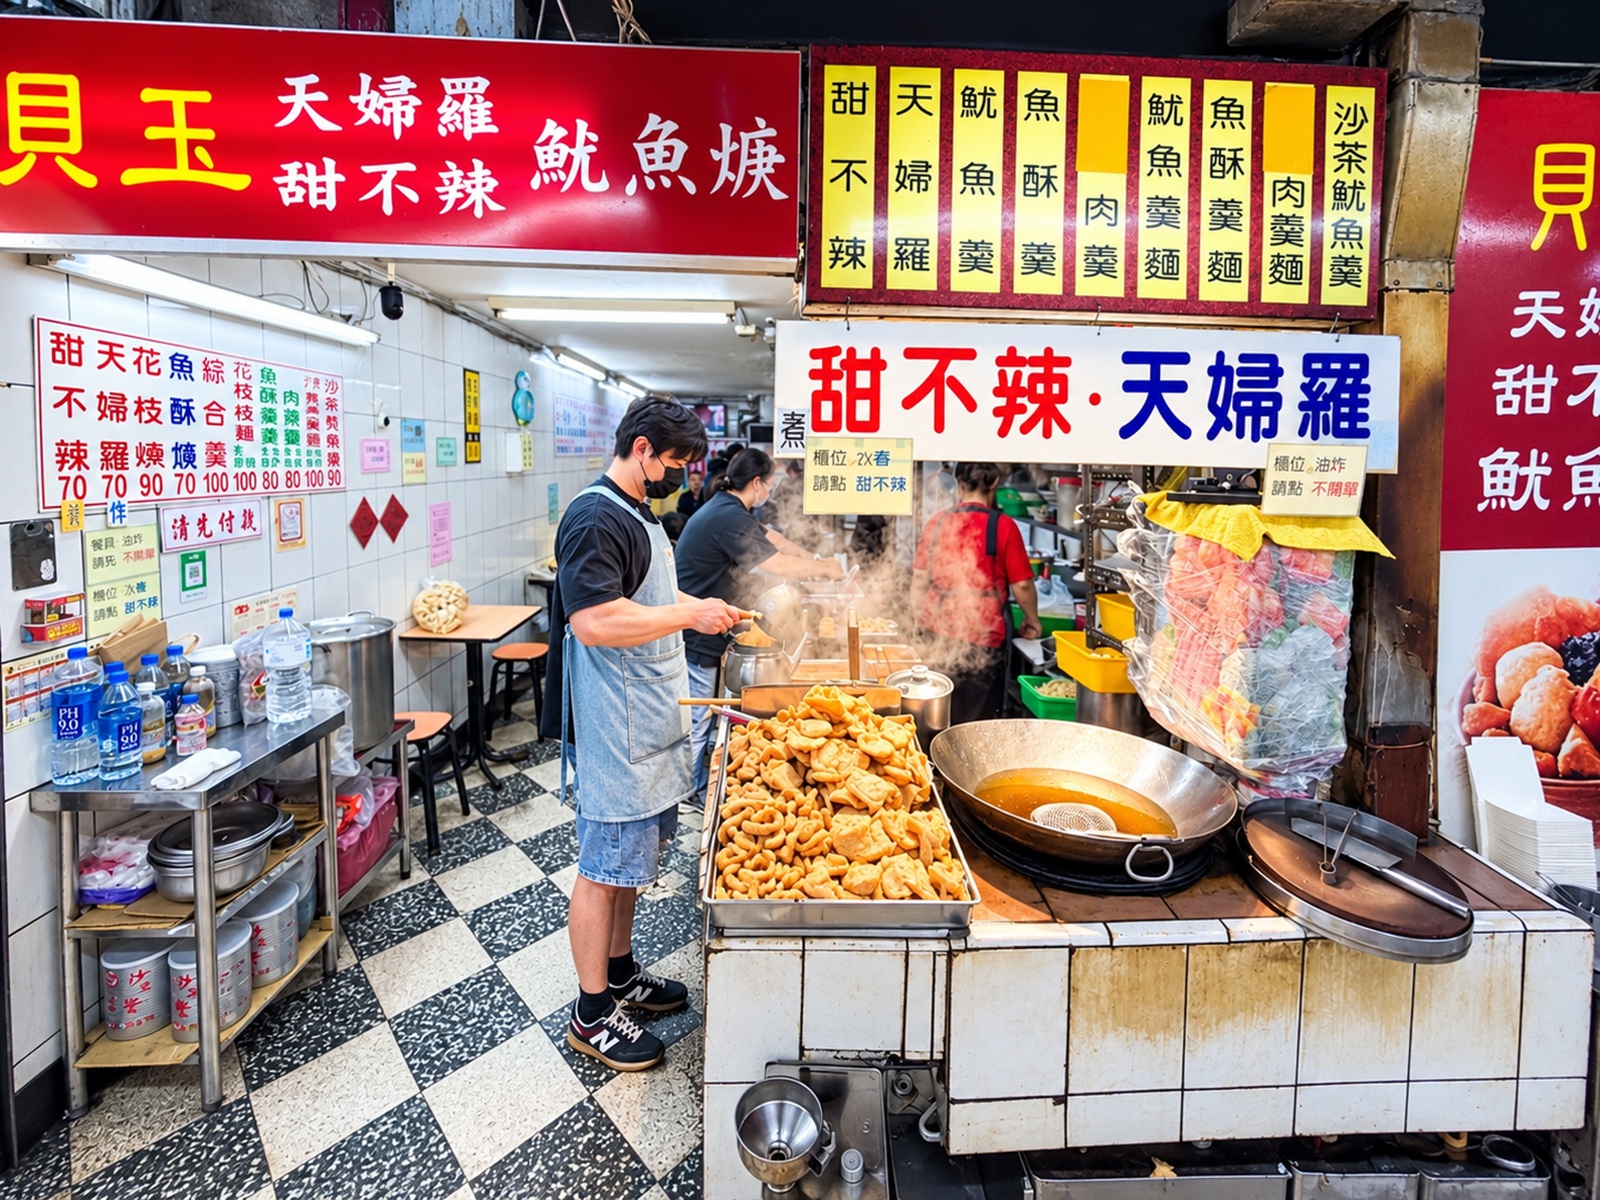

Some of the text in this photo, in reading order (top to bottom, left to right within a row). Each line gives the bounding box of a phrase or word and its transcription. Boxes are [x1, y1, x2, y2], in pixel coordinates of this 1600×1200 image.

[274, 72, 500, 142] 天婦羅
[272, 157, 506, 219] 甜不辣
[828, 81, 870, 271] 甜不辣
[892, 83, 934, 272] 天婦羅
[1530, 143, 1596, 252] 貝
[49, 331, 90, 472] 甜不辣
[96, 339, 129, 471] 天婦羅
[58, 474, 88, 501] 70
[101, 473, 128, 499] 70
[138, 472, 164, 497] 90
[173, 472, 197, 495] 70
[202, 471, 229, 493] 100
[233, 471, 257, 492] 100
[262, 470, 279, 490] 80
[285, 470, 301, 489] 80
[304, 469, 324, 488] 100
[327, 469, 342, 487] 90
[59, 706, 79, 719] PH
[589, 1028, 620, 1053] N
